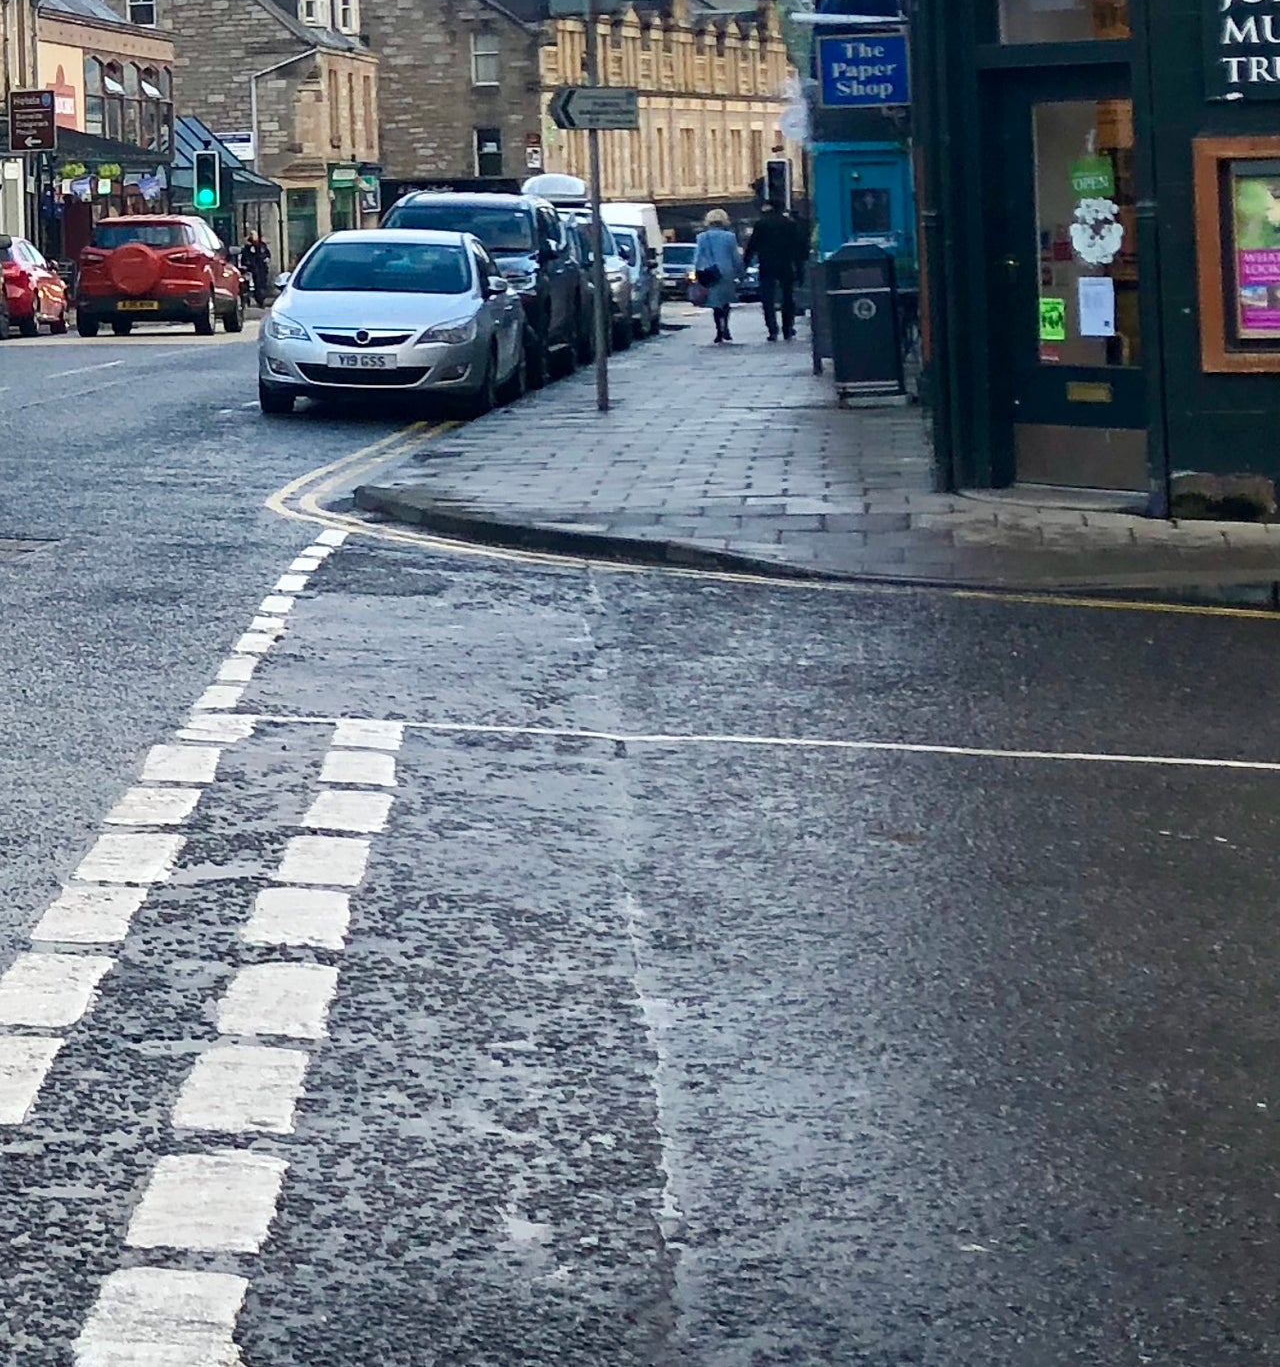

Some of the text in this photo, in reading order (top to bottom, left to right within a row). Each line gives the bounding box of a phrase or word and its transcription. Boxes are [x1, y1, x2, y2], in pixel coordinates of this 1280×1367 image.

[842, 42, 885, 59] The
[831, 62, 897, 80] Paper
[836, 80, 894, 98] Shop
[1073, 175, 1109, 191] OPEN
[339, 354, 386, 368] Y19 GSS
